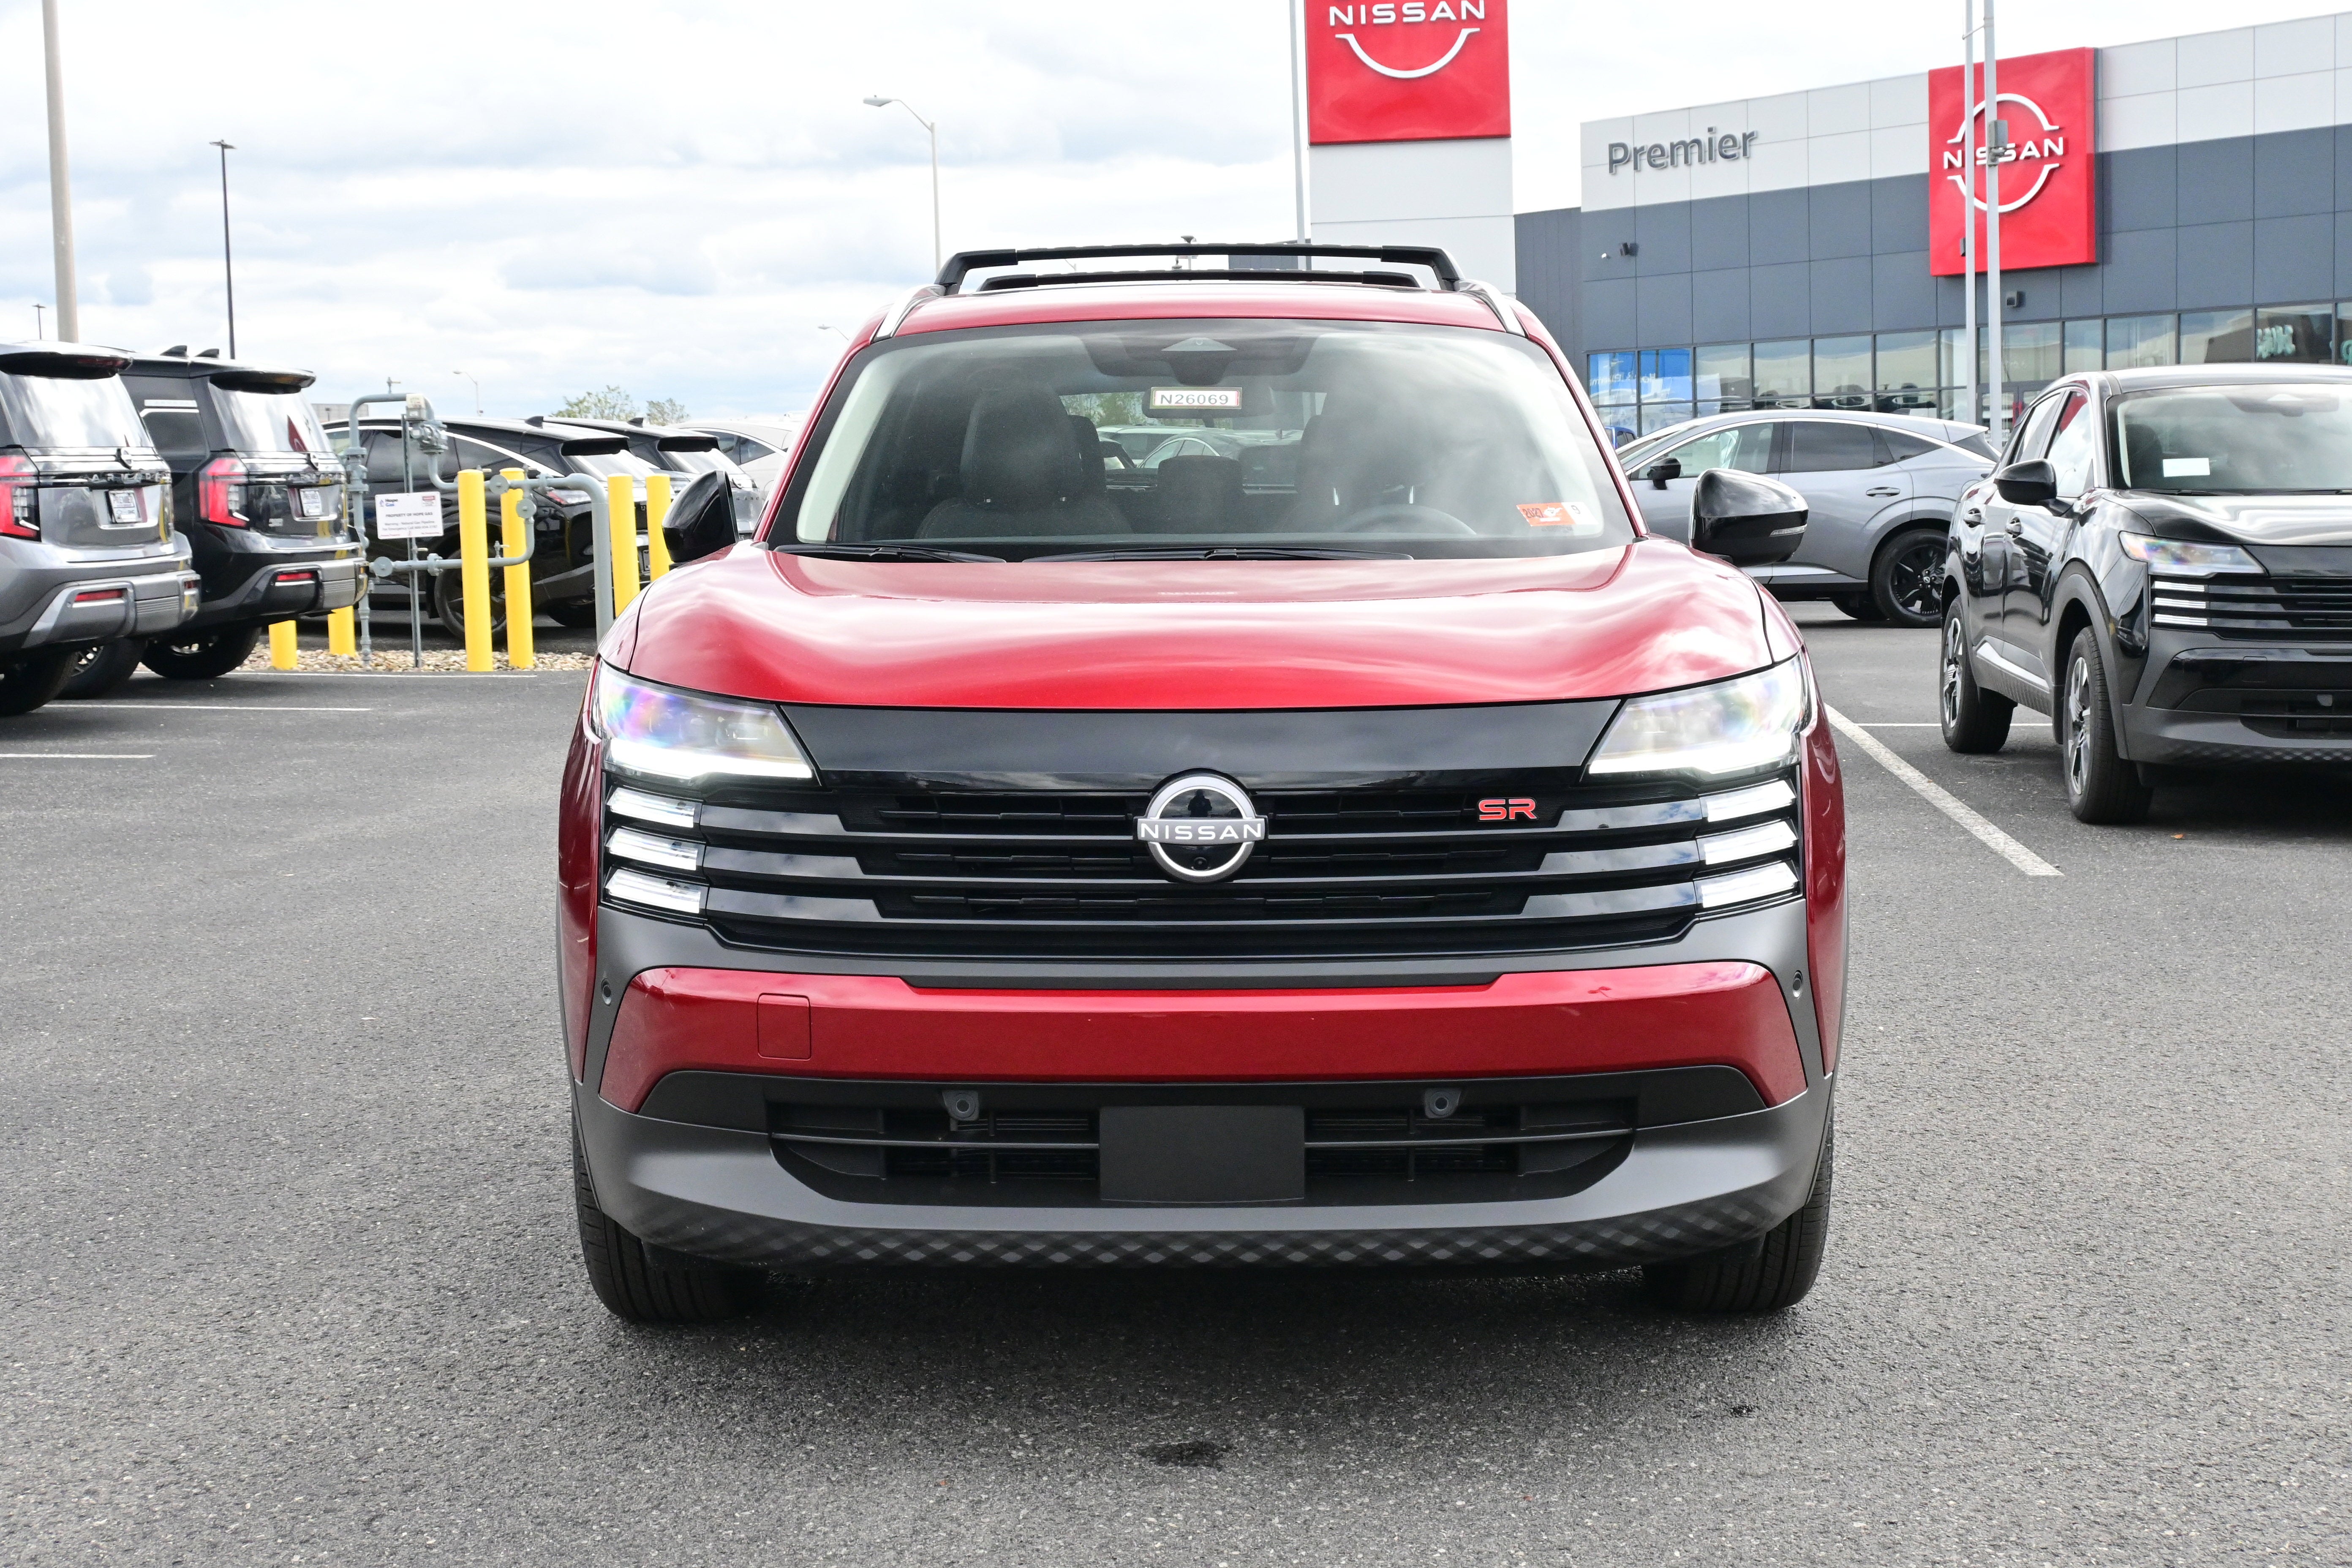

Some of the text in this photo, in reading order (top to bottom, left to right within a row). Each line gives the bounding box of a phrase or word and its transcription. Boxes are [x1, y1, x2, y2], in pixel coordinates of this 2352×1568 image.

[1329, 0, 1485, 26] NISSAN
[1608, 127, 1757, 174] Premier
[1943, 137, 2064, 170] NSSAN
[1160, 394, 1229, 405] N26069
[1522, 508, 1544, 518] 2027
[1478, 799, 1537, 821] SR
[1140, 823, 1262, 840] NISSAN
